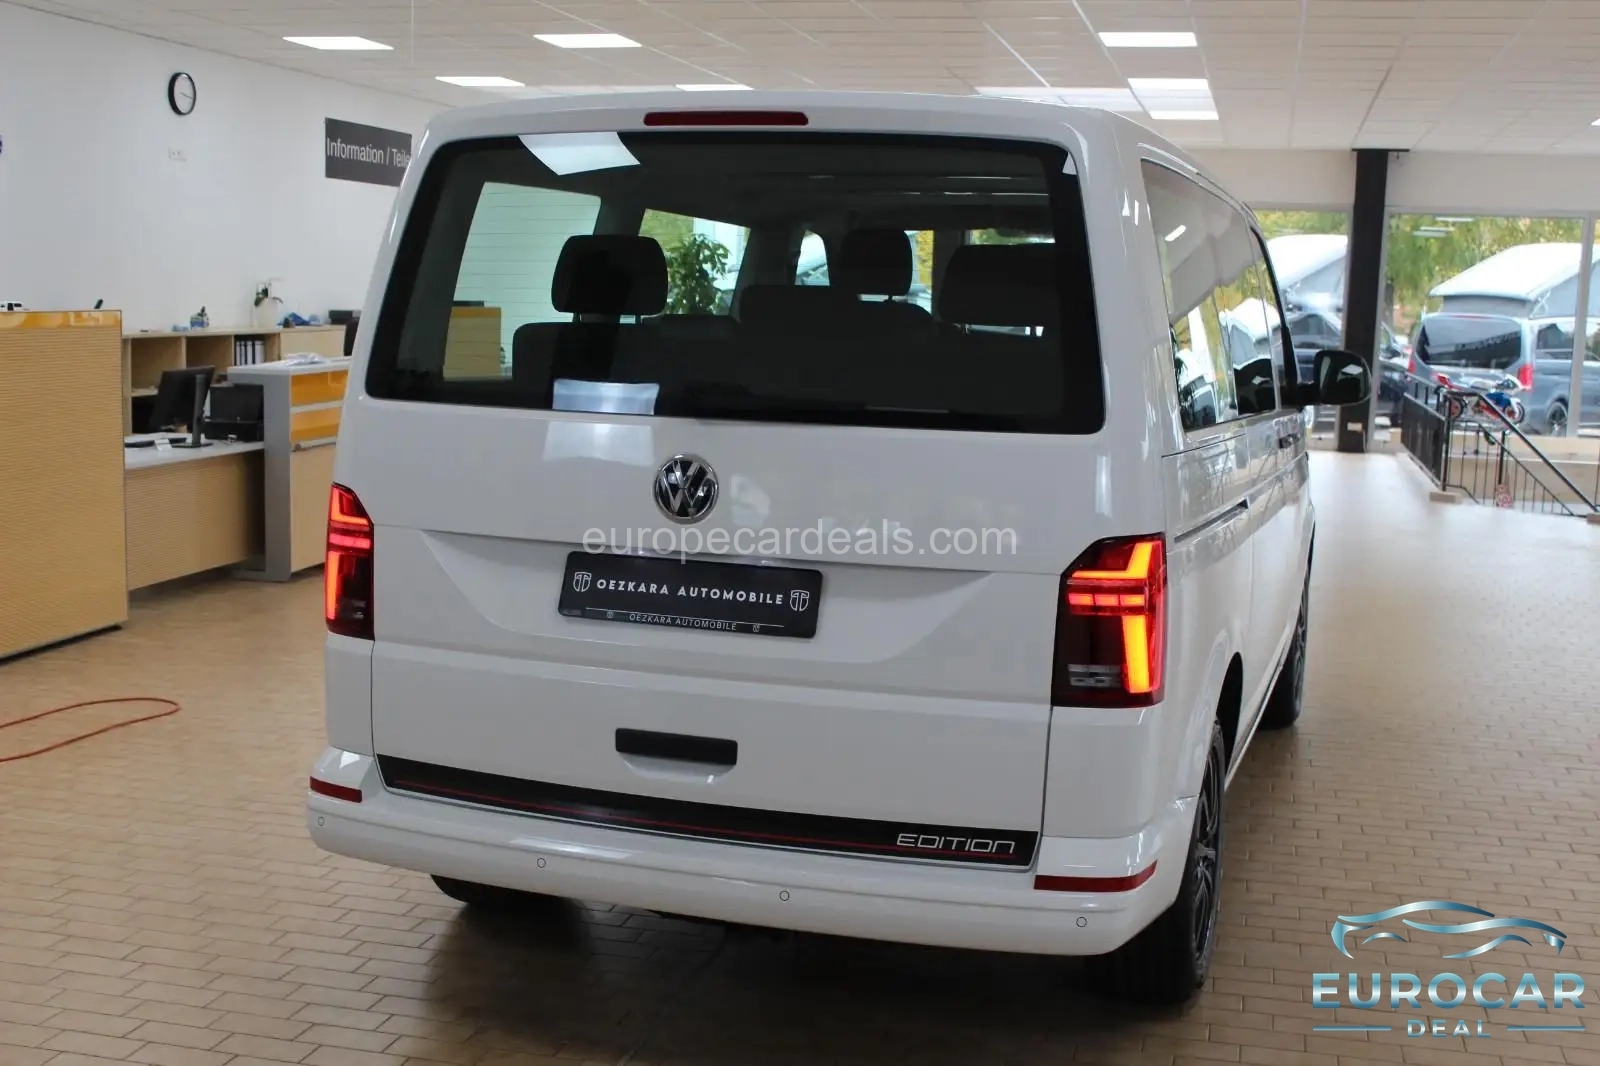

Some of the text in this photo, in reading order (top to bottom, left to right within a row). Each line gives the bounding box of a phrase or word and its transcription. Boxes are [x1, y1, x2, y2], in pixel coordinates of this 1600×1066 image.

[326, 136, 384, 164] Information
[597, 579, 783, 605] OEZKARA AUTOMOBILE
[629, 613, 737, 631] OEZKARA AUTOMOBILE
[896, 833, 1016, 854] EDITION
